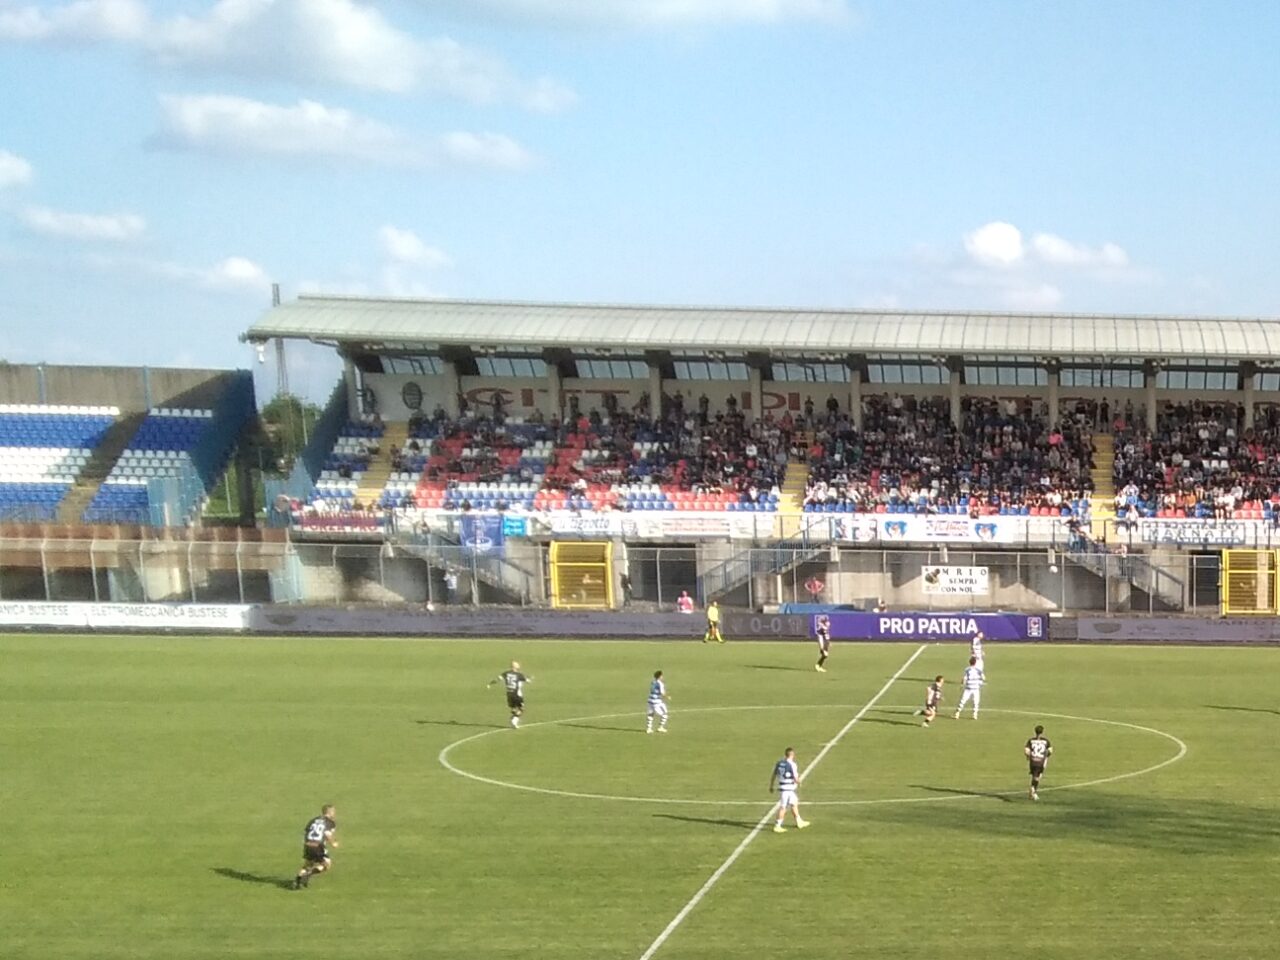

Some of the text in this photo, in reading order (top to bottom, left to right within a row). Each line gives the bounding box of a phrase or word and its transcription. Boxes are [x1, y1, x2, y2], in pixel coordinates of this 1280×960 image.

[27, 604, 68, 616] BUSTESE
[91, 605, 229, 619] ELETTROMECCANICA BUSTESE
[879, 617, 979, 635] PRO PATRIA
[1030, 744, 1046, 758] 32
[307, 823, 325, 841] 29
